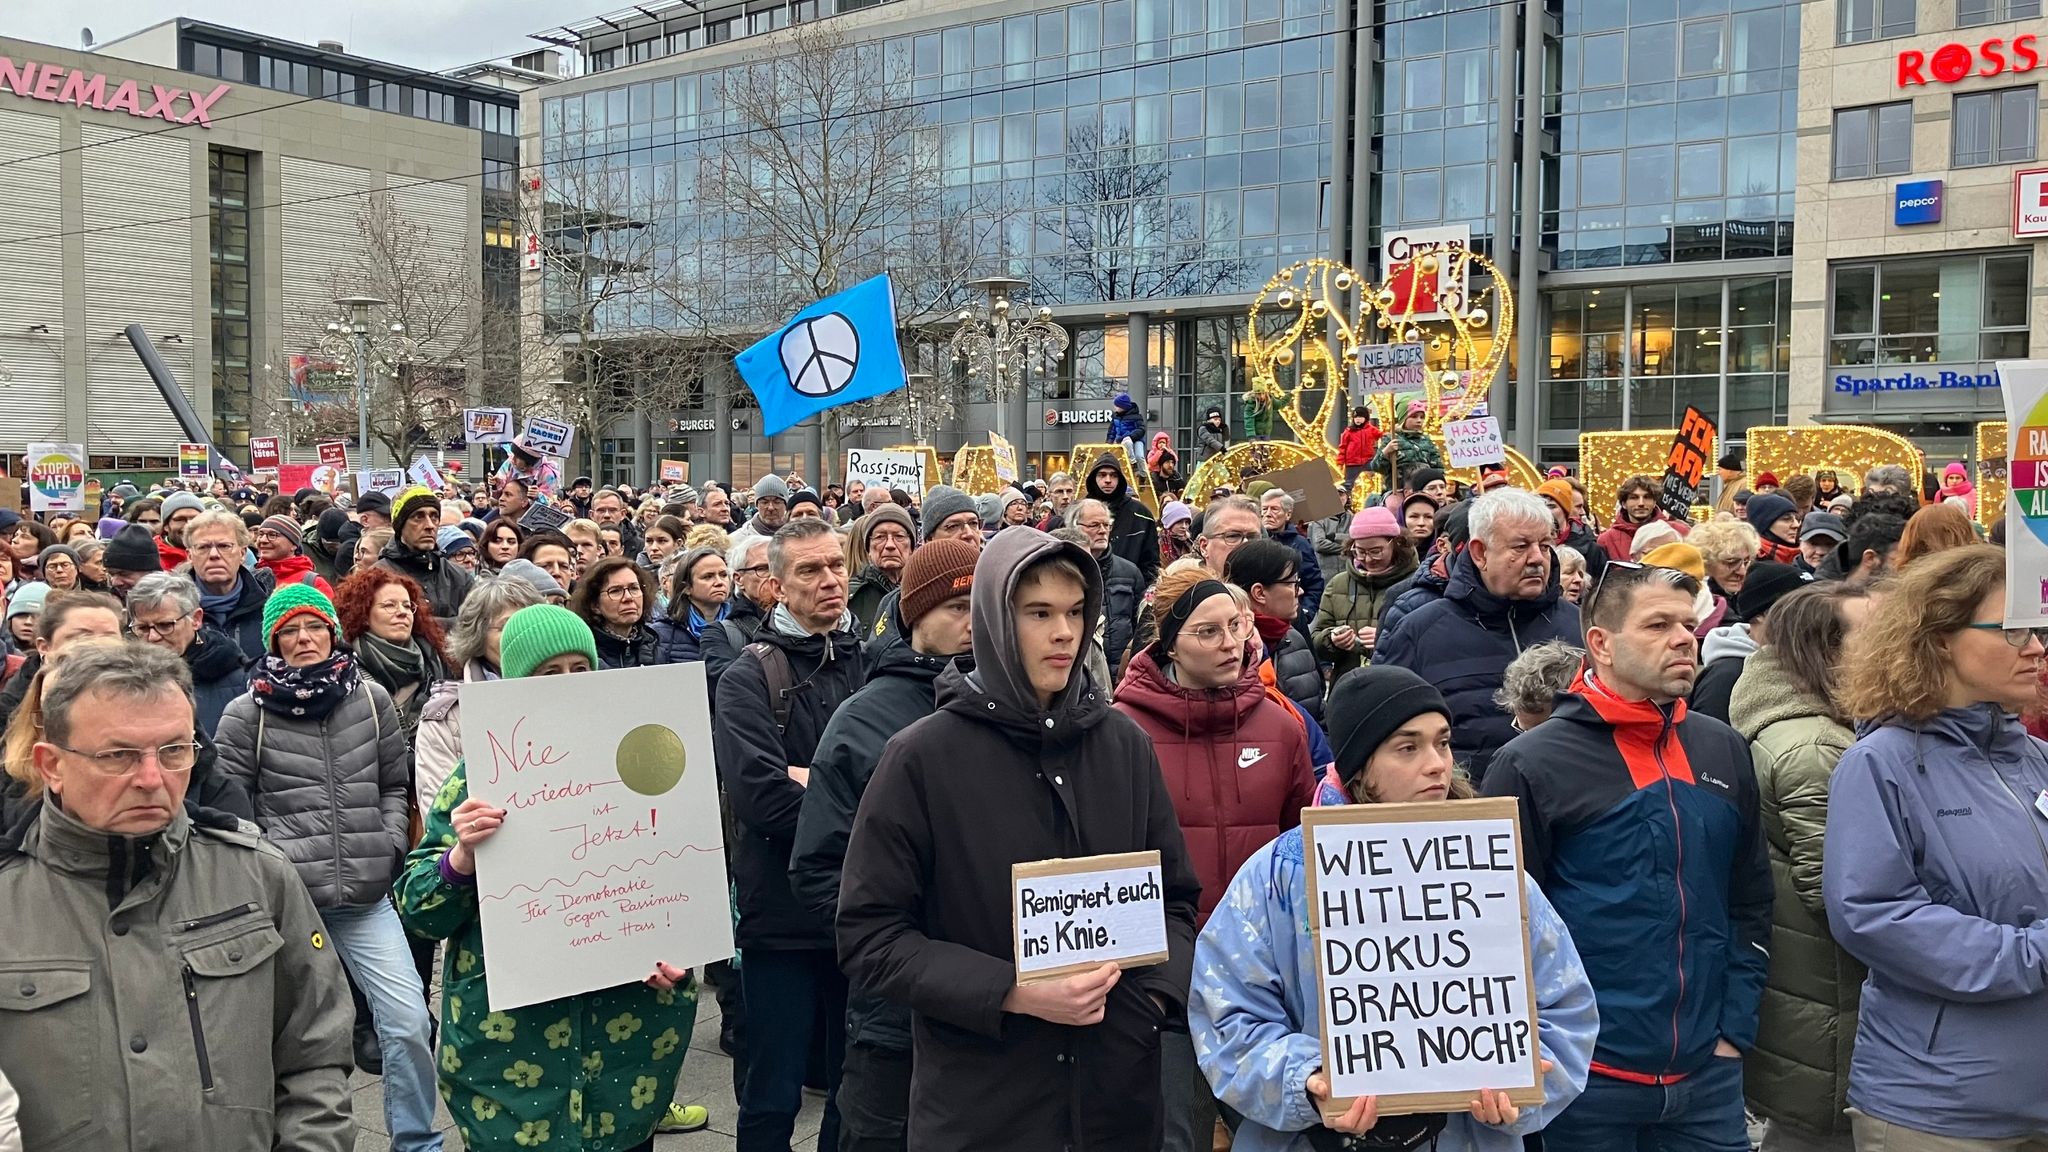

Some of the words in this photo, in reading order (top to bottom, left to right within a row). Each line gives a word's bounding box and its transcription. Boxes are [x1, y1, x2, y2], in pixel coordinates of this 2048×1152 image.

[1897, 33, 2048, 88] ROSS
[1900, 197, 1936, 209] pepco
[2024, 214, 2048, 224] Kau
[1364, 351, 1383, 366] NIE
[1362, 365, 1424, 389] FASCHISMUS
[680, 419, 715, 431] BURGER
[1062, 409, 1113, 424] BURGER
[1451, 421, 1488, 438] HASS
[1461, 436, 1485, 445] MACHT
[1680, 407, 1717, 455] FCK
[253, 440, 274, 449] Nazis
[253, 449, 278, 458] töten.
[1452, 444, 1500, 459] HÄSSLICH
[850, 452, 924, 478] Rassismus
[1668, 442, 1703, 488] AFD
[46, 474, 71, 490] AFD
[486, 716, 570, 785] Nie
[1241, 747, 1261, 760] NIKE
[506, 779, 600, 809] wieder
[593, 803, 619, 816] ist
[550, 808, 657, 860] Jetzt!
[1317, 839, 1393, 876] WIE
[1402, 834, 1514, 873] VIELE
[516, 899, 552, 924] Für
[555, 876, 655, 912] Demokratie
[1021, 882, 1114, 918] Remigriert
[1117, 871, 1160, 904] euch
[1322, 881, 1505, 928] HITLER-
[569, 931, 613, 948] und
[617, 922, 656, 937] Hass
[1023, 929, 1049, 958] ins
[1055, 918, 1117, 953] Knie.
[1326, 929, 1471, 976] DOKUS
[1330, 975, 1516, 1026] BRAUCHT
[1334, 1029, 1406, 1076] IHR
[1417, 1020, 1529, 1068] NOCH?
